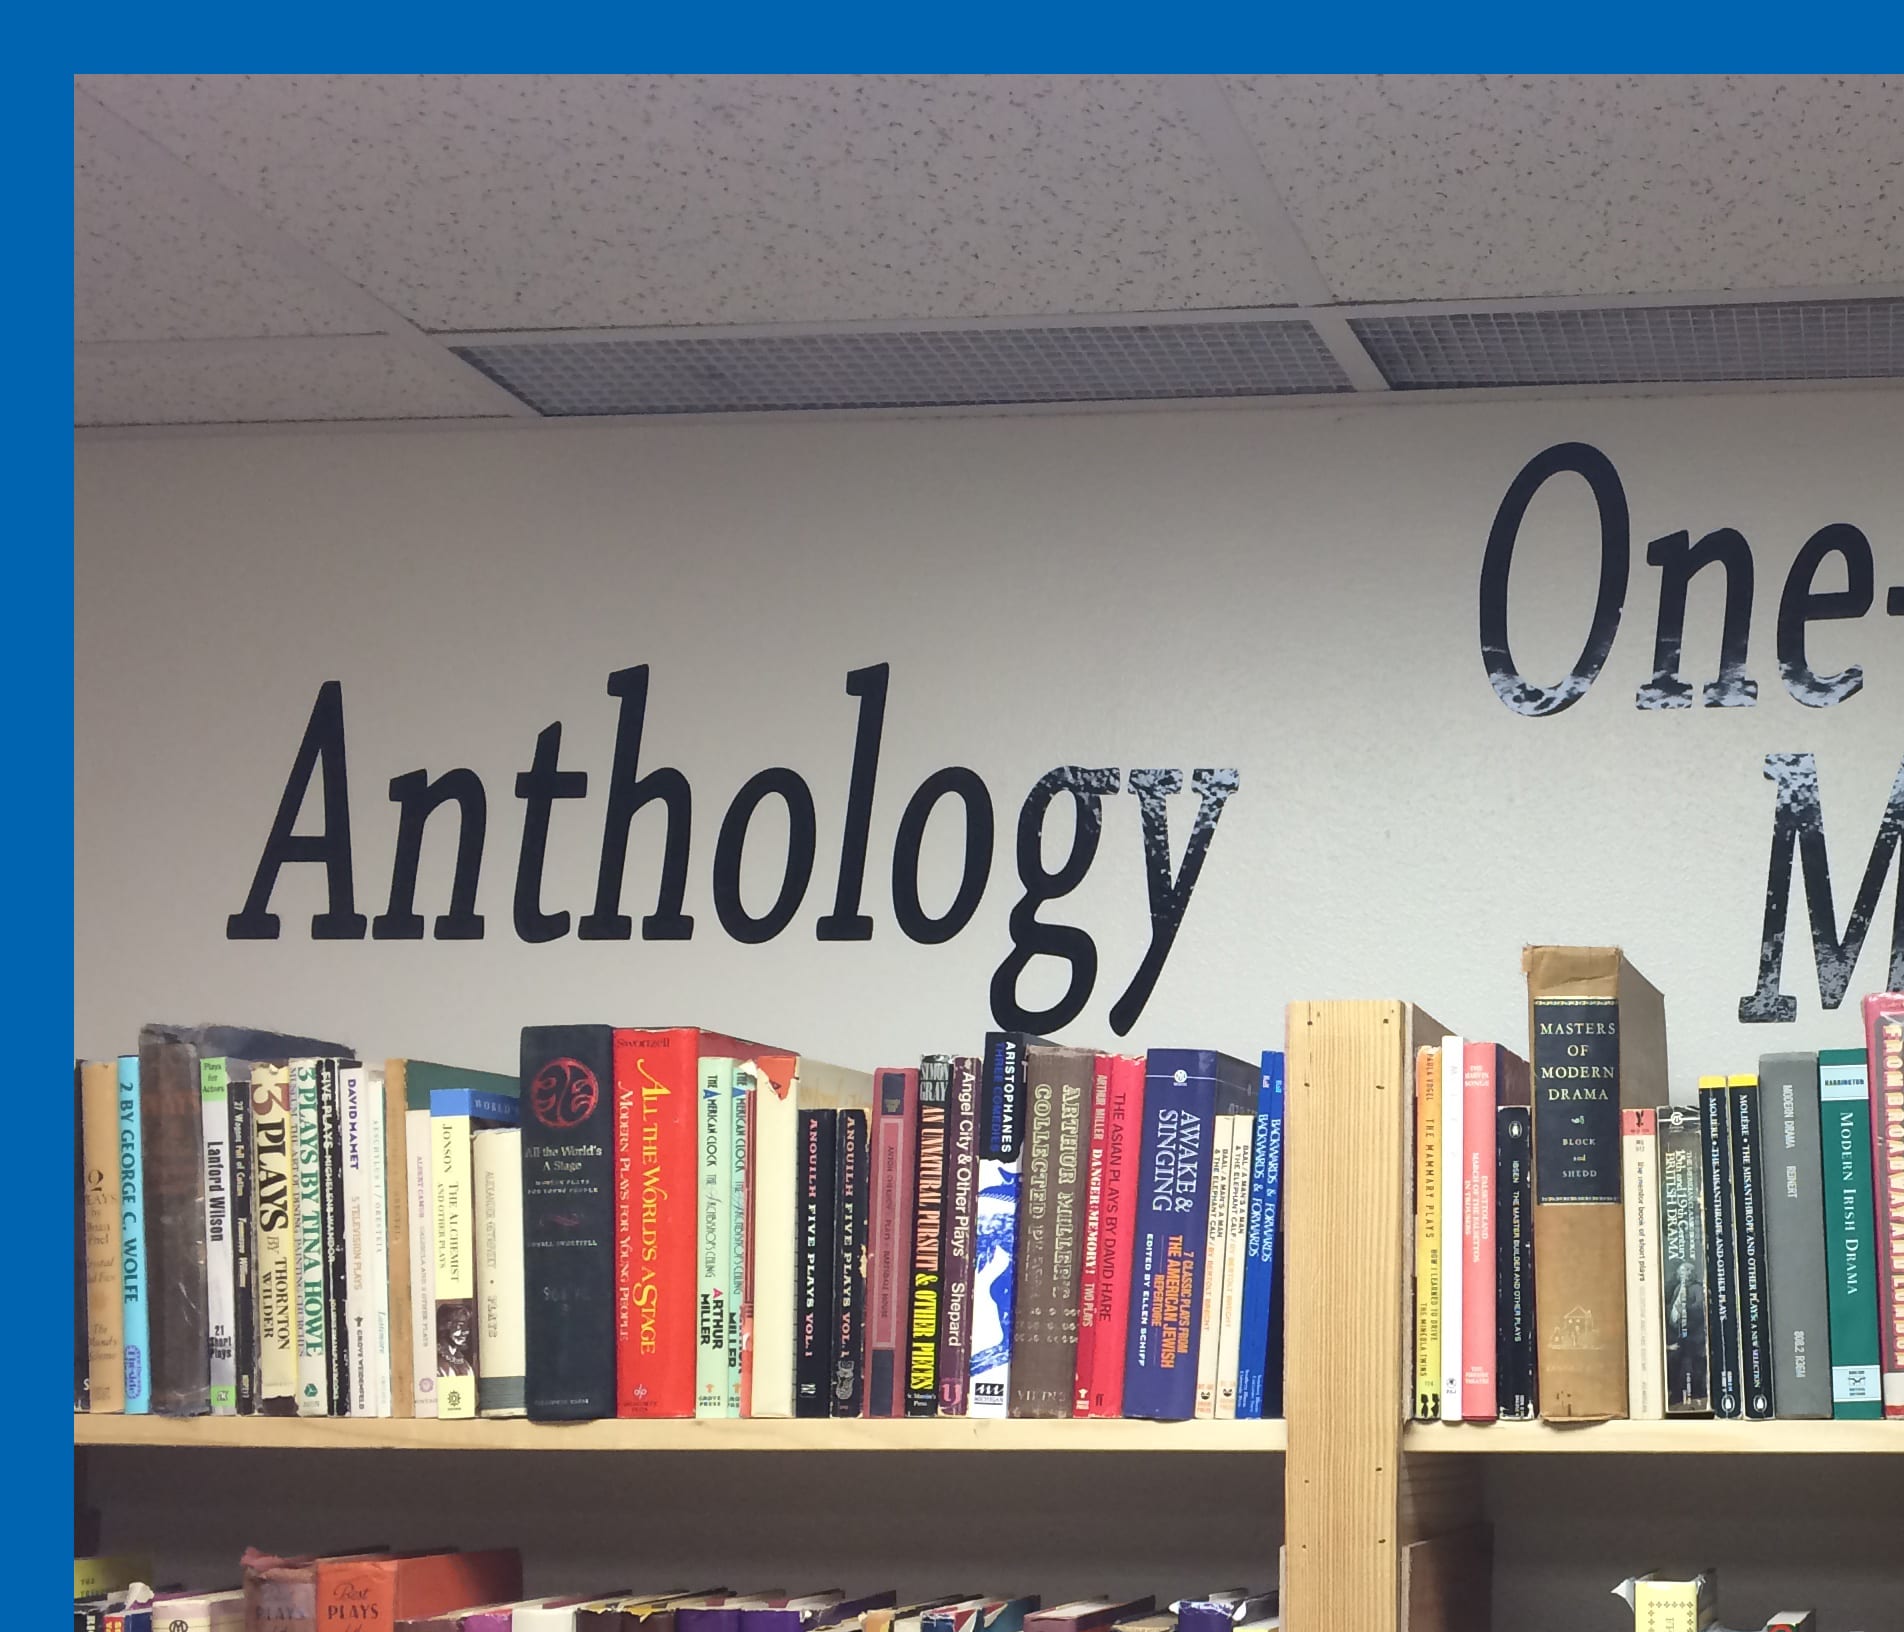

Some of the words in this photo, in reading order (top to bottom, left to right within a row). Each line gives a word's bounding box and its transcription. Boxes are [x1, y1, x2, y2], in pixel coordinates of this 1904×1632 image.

[227, 663, 1238, 1036] Anthology
[1540, 1023, 1615, 1035] MASTERS
[1568, 1045, 1589, 1056] OF
[1541, 1067, 1614, 1078] MODERN
[1549, 1088, 1608, 1100] DRAMA
[348, 1079, 358, 1119] DAVID
[1001, 1041, 1016, 1153] ARISTOPHANES
[348, 1122, 359, 1170] MAMET
[1153, 1110, 1178, 1212] SINGING
[1179, 1110, 1201, 1194] AWAKE
[1840, 1112, 1853, 1181] MODERN
[1174, 1195, 1193, 1213] &
[1842, 1188, 1855, 1234] IRISH
[1845, 1239, 1857, 1295] DRAMA
